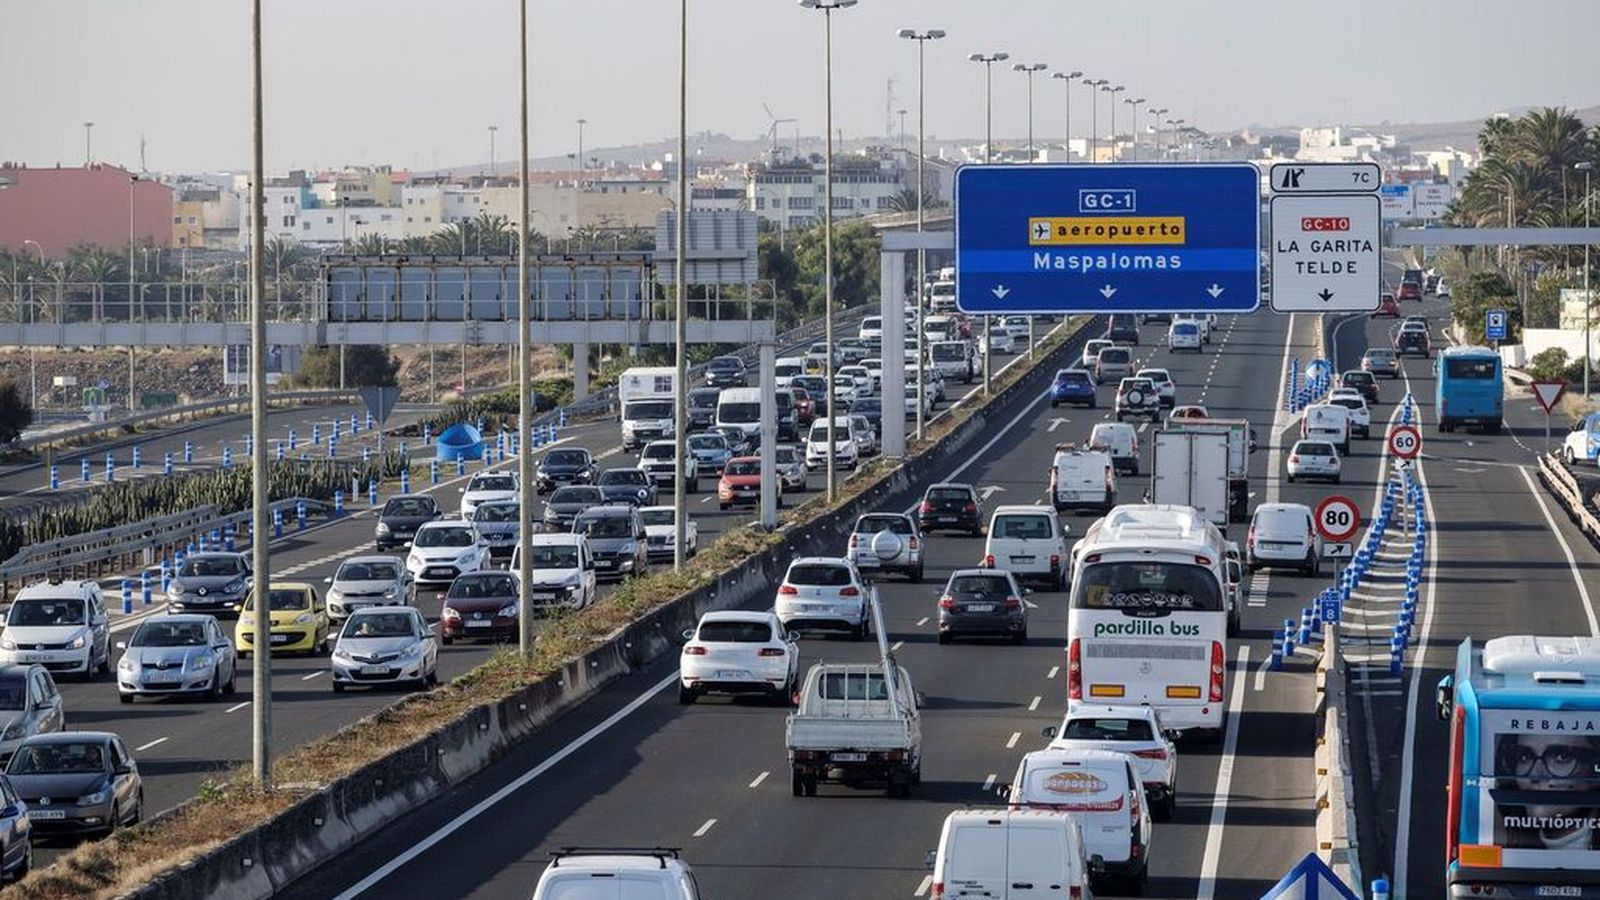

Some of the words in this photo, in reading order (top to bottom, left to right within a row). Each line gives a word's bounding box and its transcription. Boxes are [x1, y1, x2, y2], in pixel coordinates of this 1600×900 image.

[1352, 172, 1370, 183] 7C
[1084, 193, 1131, 208] GC-1
[1058, 223, 1181, 239] aeropuerto
[1303, 219, 1348, 230] GC-10
[1277, 240, 1300, 253] LA
[1310, 240, 1374, 253] GARITA
[1034, 252, 1182, 274] Maspalomas
[1295, 261, 1357, 274] TELDE
[1396, 436, 1414, 448] 60
[1326, 510, 1349, 526] 80
[1326, 608, 1335, 620] 8
[1094, 619, 1164, 638] pardilla
[1170, 620, 1200, 636] bus
[1511, 719, 1595, 731] REBAJA
